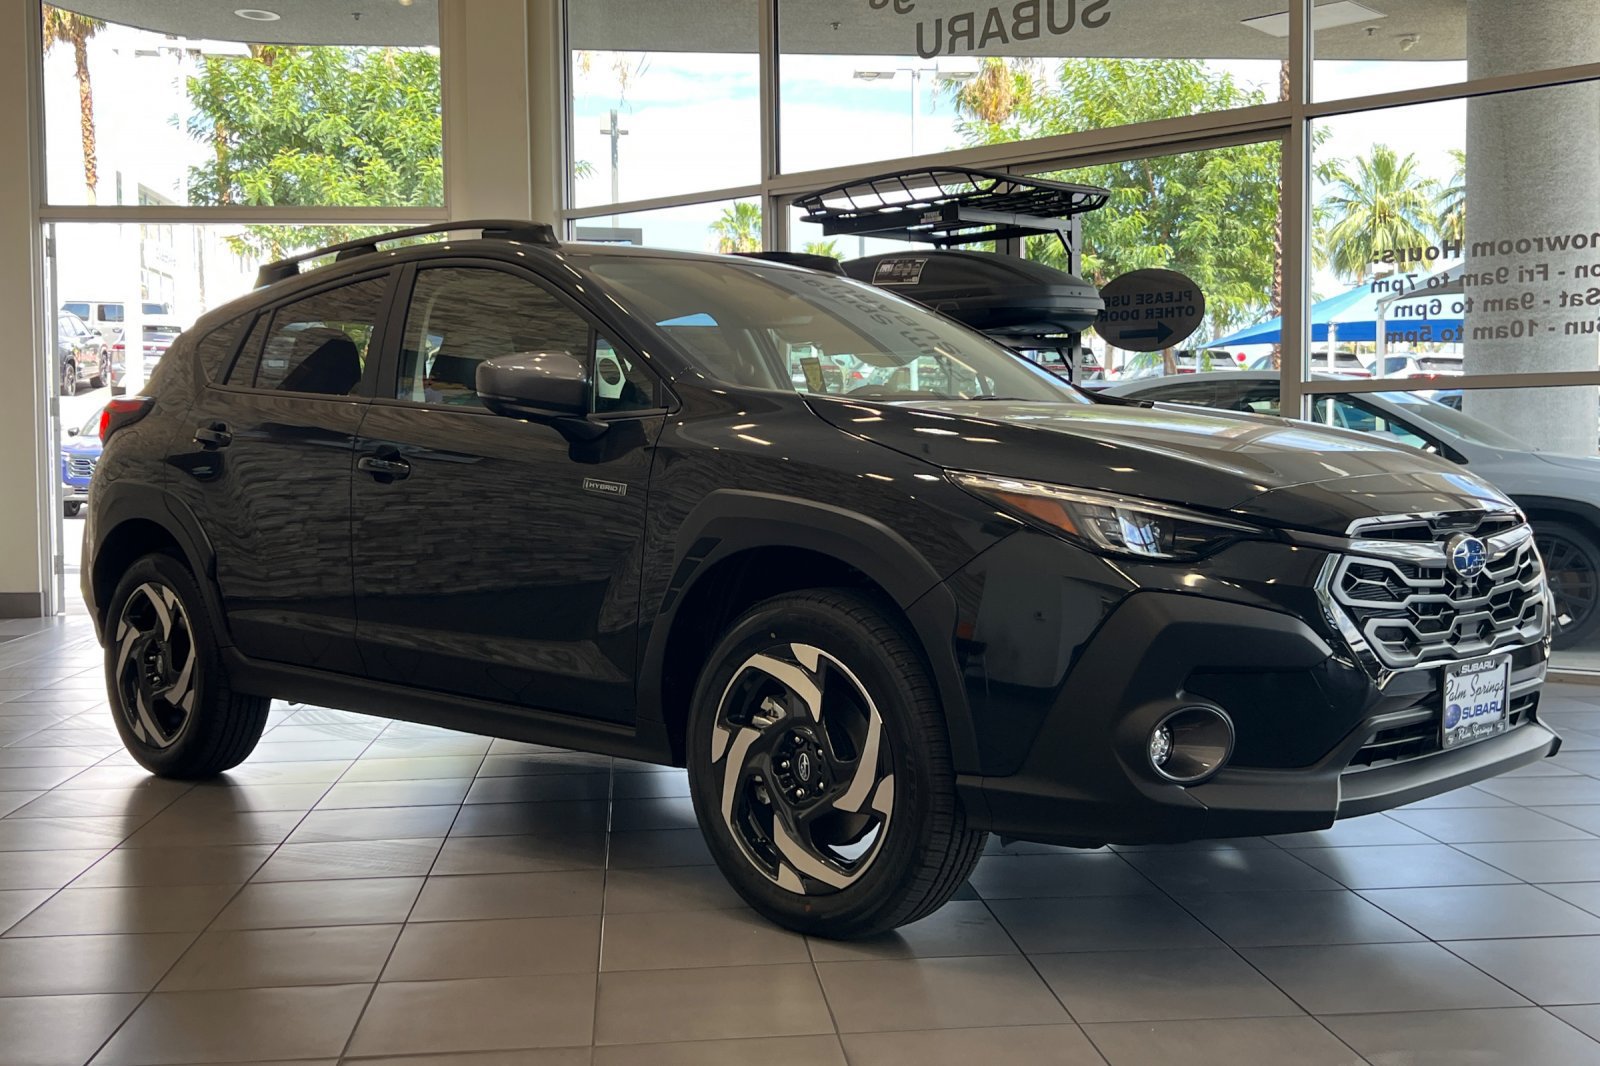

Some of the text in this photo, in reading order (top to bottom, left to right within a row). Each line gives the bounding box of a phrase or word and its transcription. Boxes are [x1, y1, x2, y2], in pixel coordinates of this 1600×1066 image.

[588, 482, 618, 492] HYBRID
[1461, 659, 1495, 674] SUBARU
[1446, 673, 1504, 703] Palm Springs
[1461, 700, 1503, 720] SUBARU
